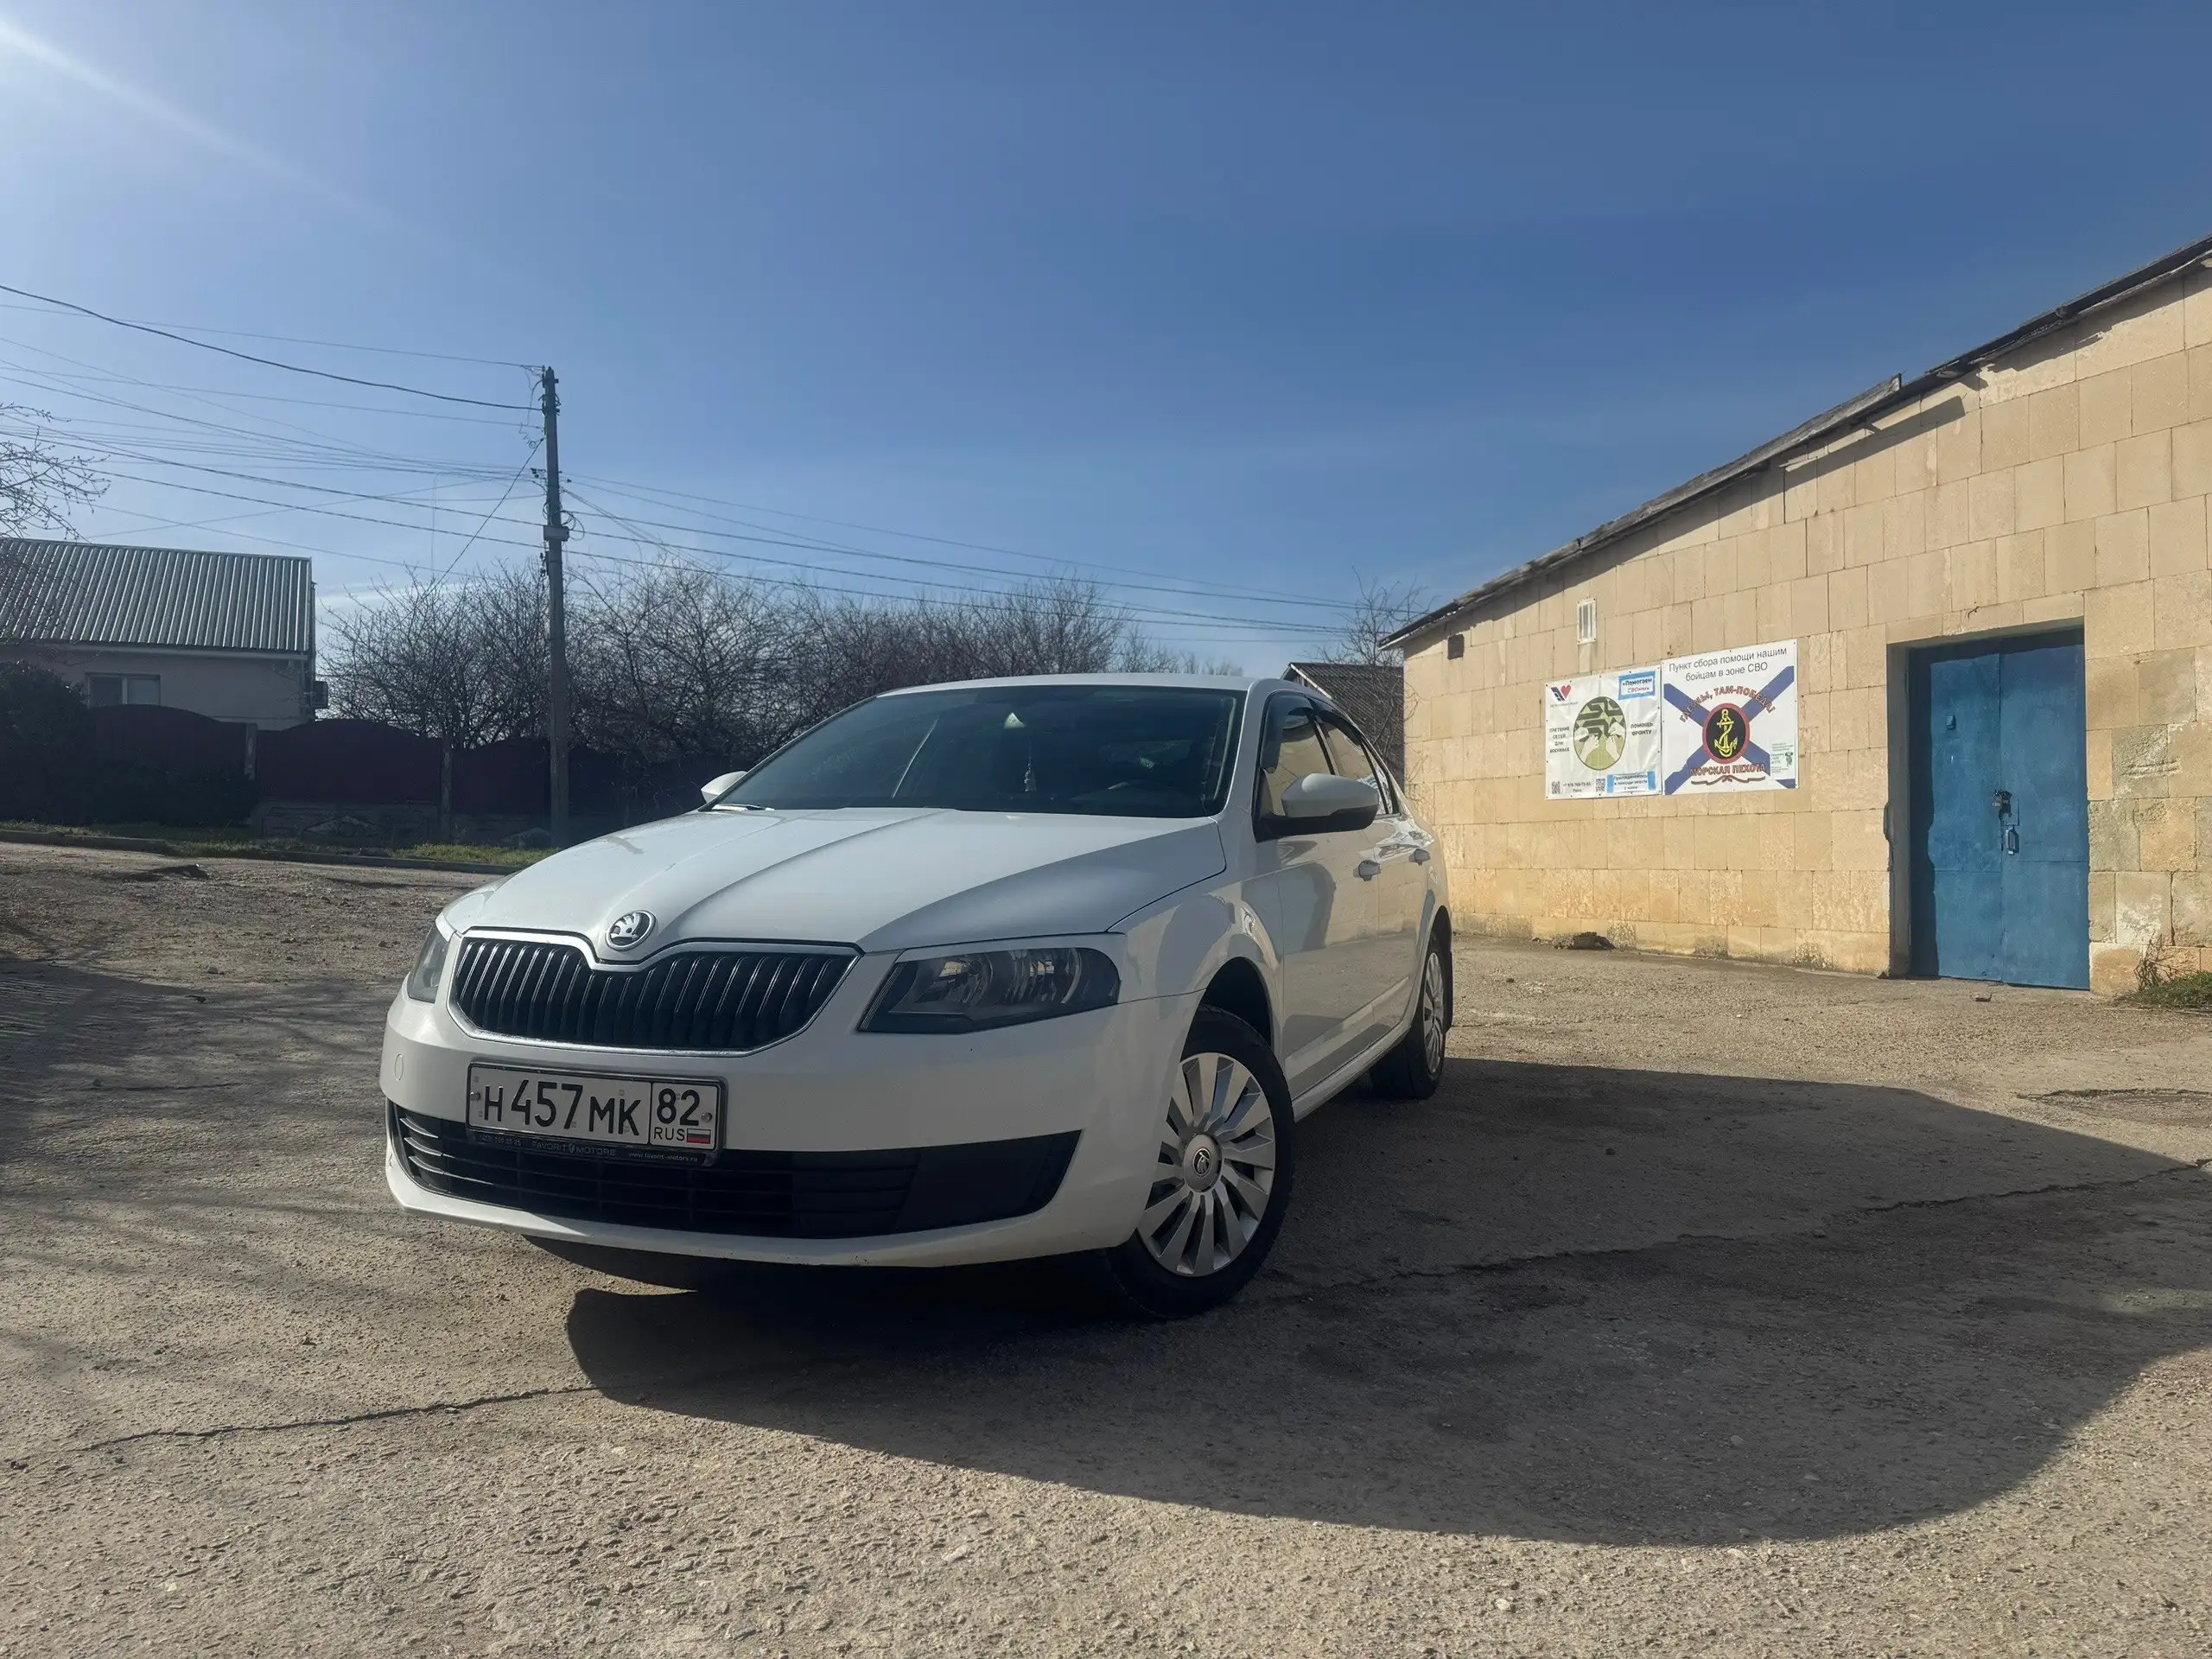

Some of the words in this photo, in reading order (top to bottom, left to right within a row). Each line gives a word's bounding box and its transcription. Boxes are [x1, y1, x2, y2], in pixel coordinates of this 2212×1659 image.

[1669, 663, 1692, 672] Пункт
[1694, 658, 1718, 669] сбора
[1720, 653, 1754, 664] помощи
[1757, 647, 1787, 658] нашим
[1685, 671, 1717, 682] бойцам
[1726, 666, 1745, 675] зоне
[1747, 661, 1768, 672] СВО
[1690, 766, 1730, 776] МОРСКАЯ
[1732, 764, 1766, 774] ПЕХОТА
[656, 1088, 701, 1127] 82
[653, 1126, 686, 1141] RUS
[531, 1141, 568, 1152] FAVORIT
[575, 1146, 616, 1157] MOTORS
